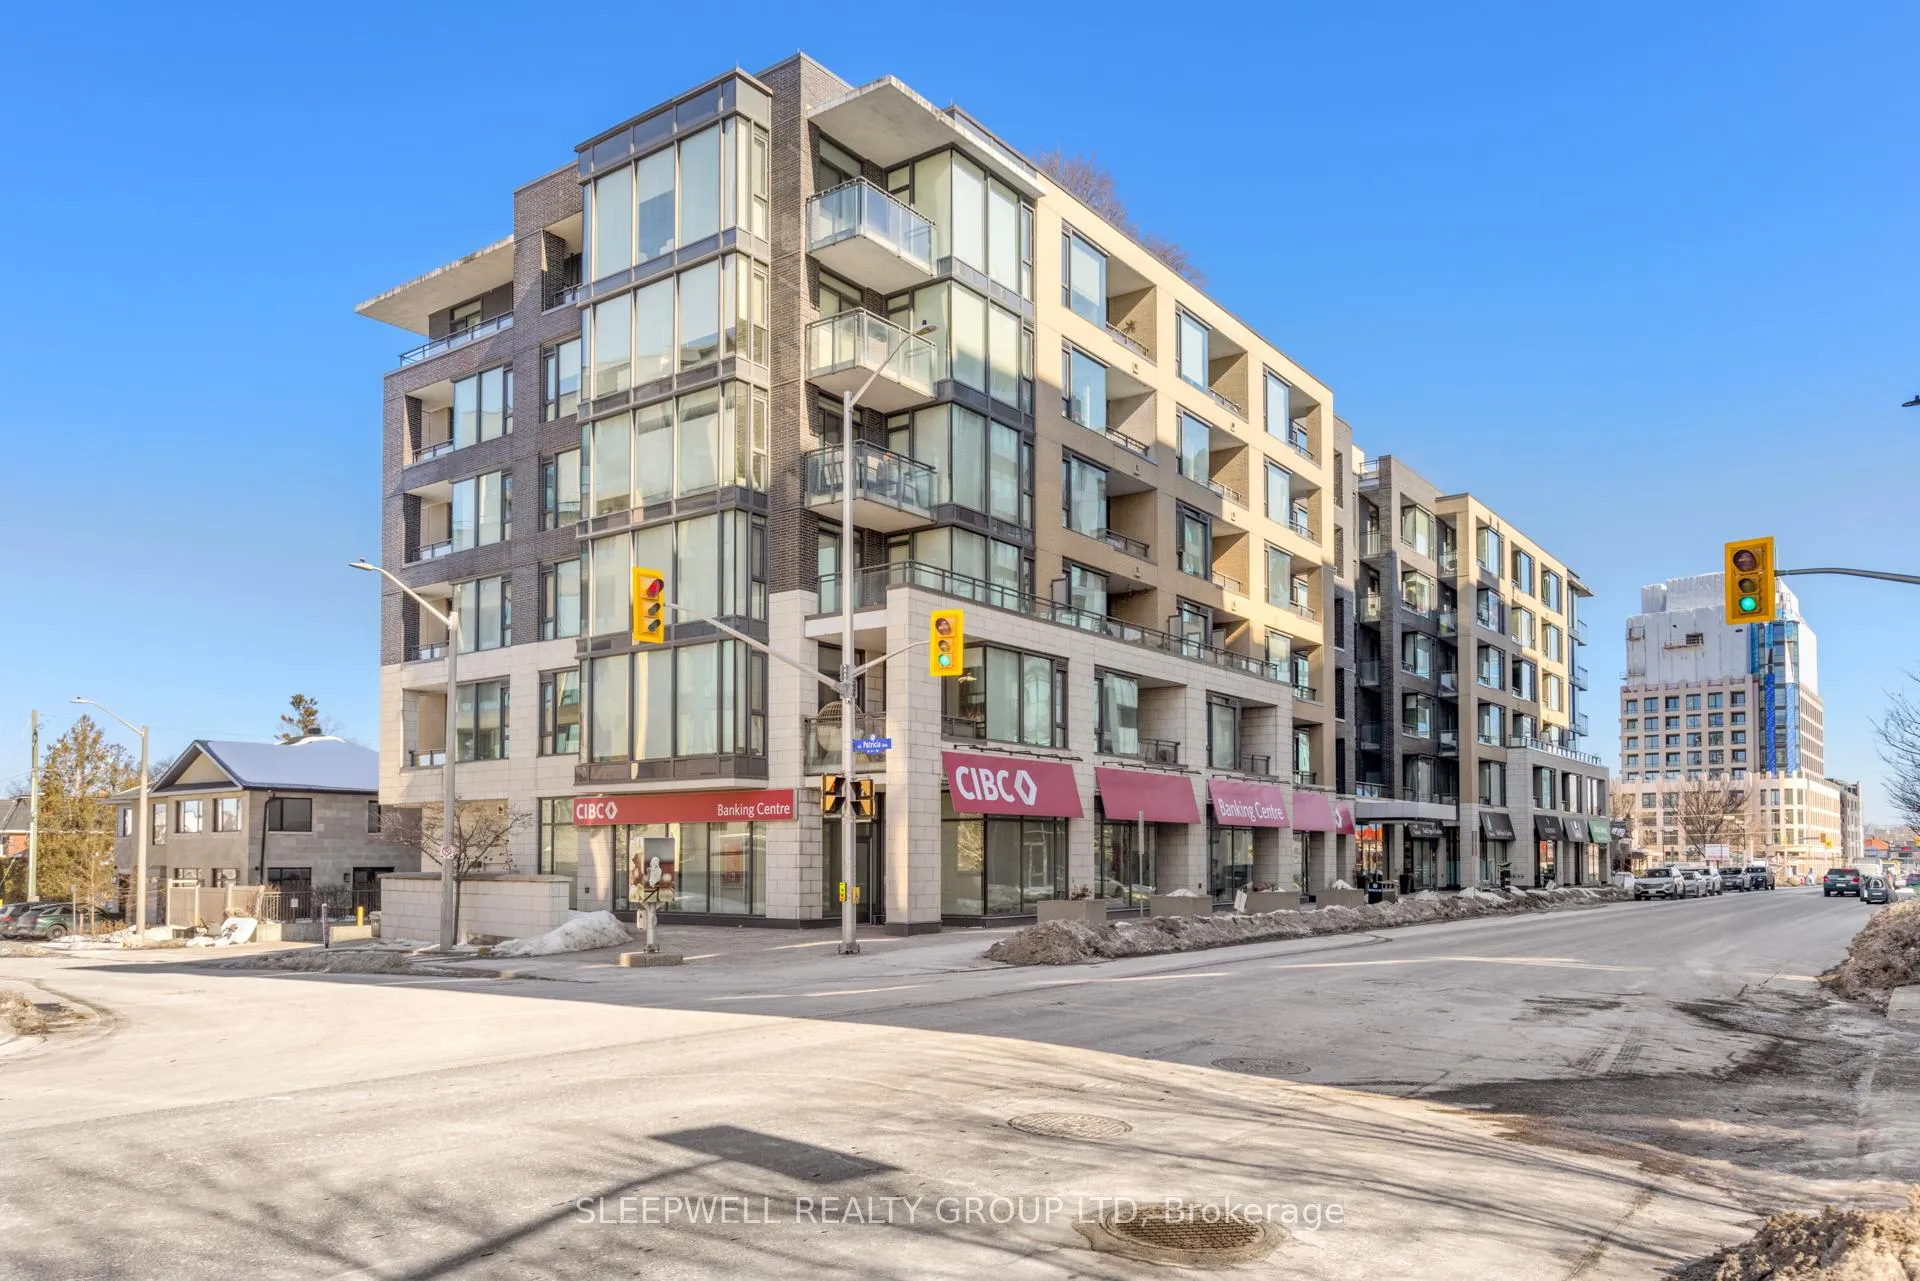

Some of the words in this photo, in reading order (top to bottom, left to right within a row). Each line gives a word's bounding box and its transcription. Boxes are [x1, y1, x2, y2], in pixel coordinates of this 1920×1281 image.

[863, 740, 881, 749] Patricia
[955, 766, 1015, 803] CIBC
[576, 803, 604, 820] CIBC
[717, 803, 755, 817] Banking
[757, 802, 790, 815] Centre
[1218, 798, 1256, 822] Banking
[1255, 801, 1284, 820] Centre
